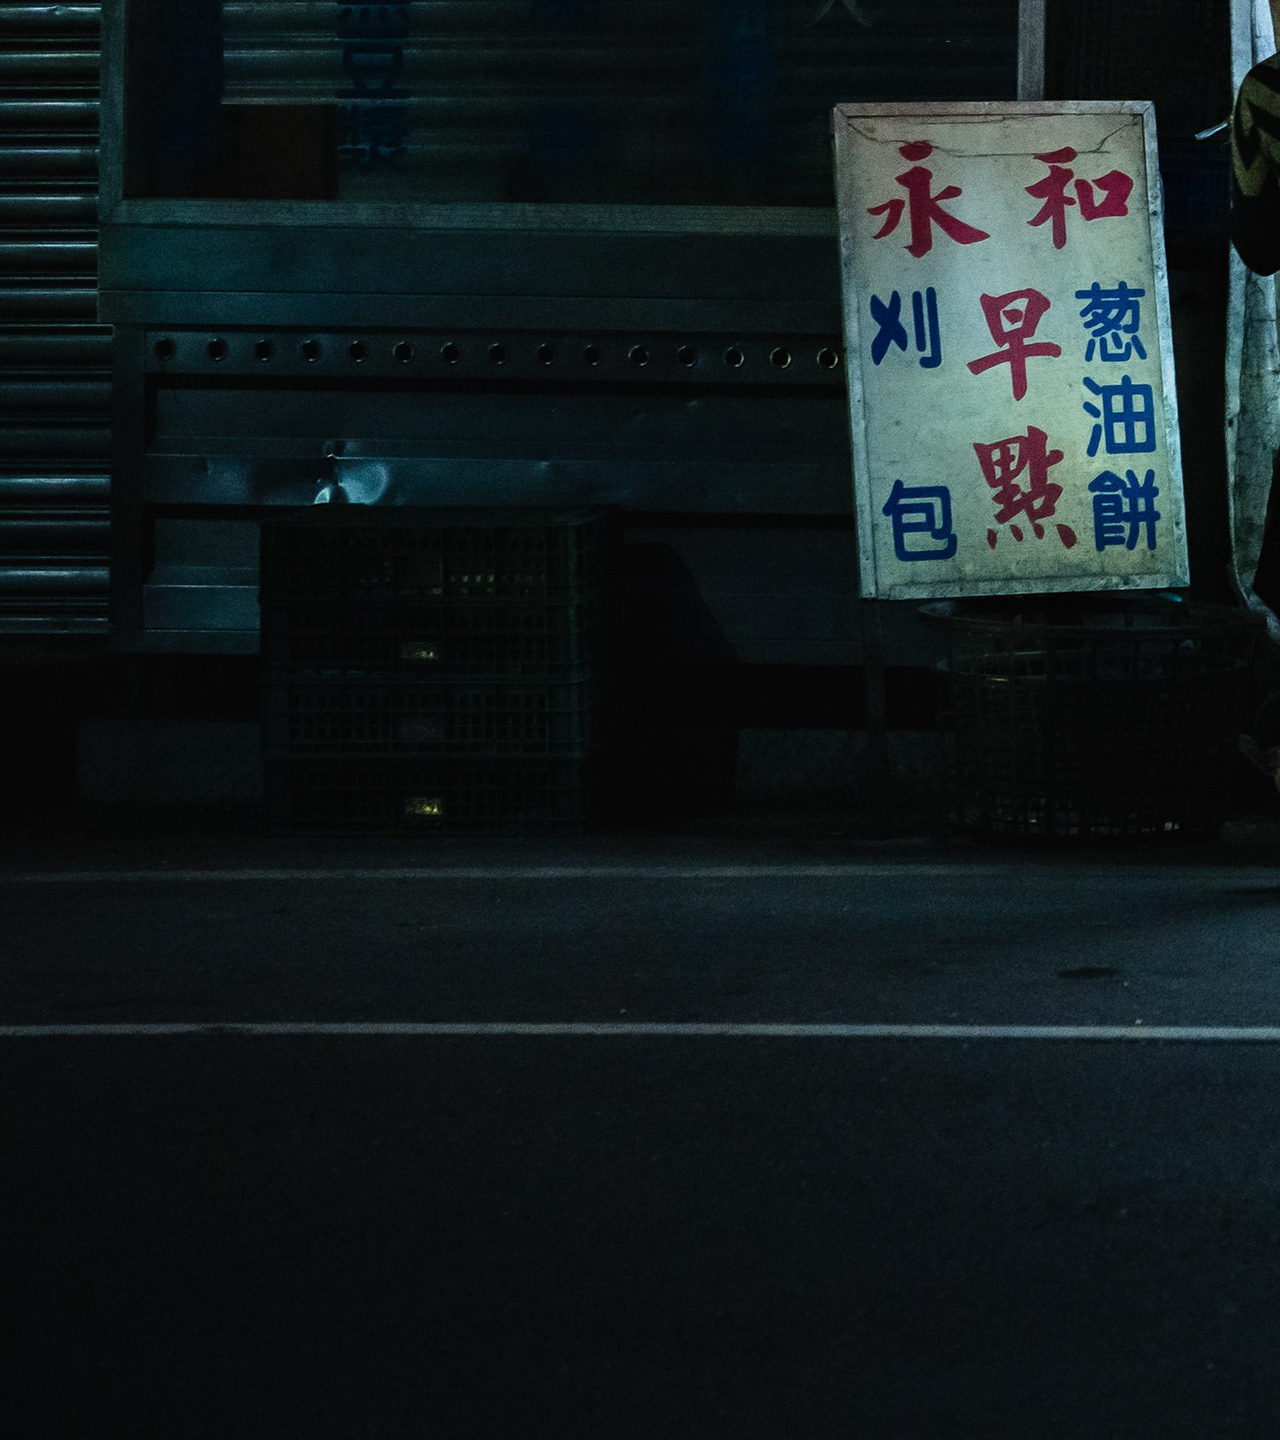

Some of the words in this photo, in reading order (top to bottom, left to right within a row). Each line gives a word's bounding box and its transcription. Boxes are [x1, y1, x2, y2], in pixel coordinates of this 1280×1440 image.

[868, 140, 1134, 258] 永和
[870, 286, 957, 561] 刈包
[967, 287, 1077, 550] 早點
